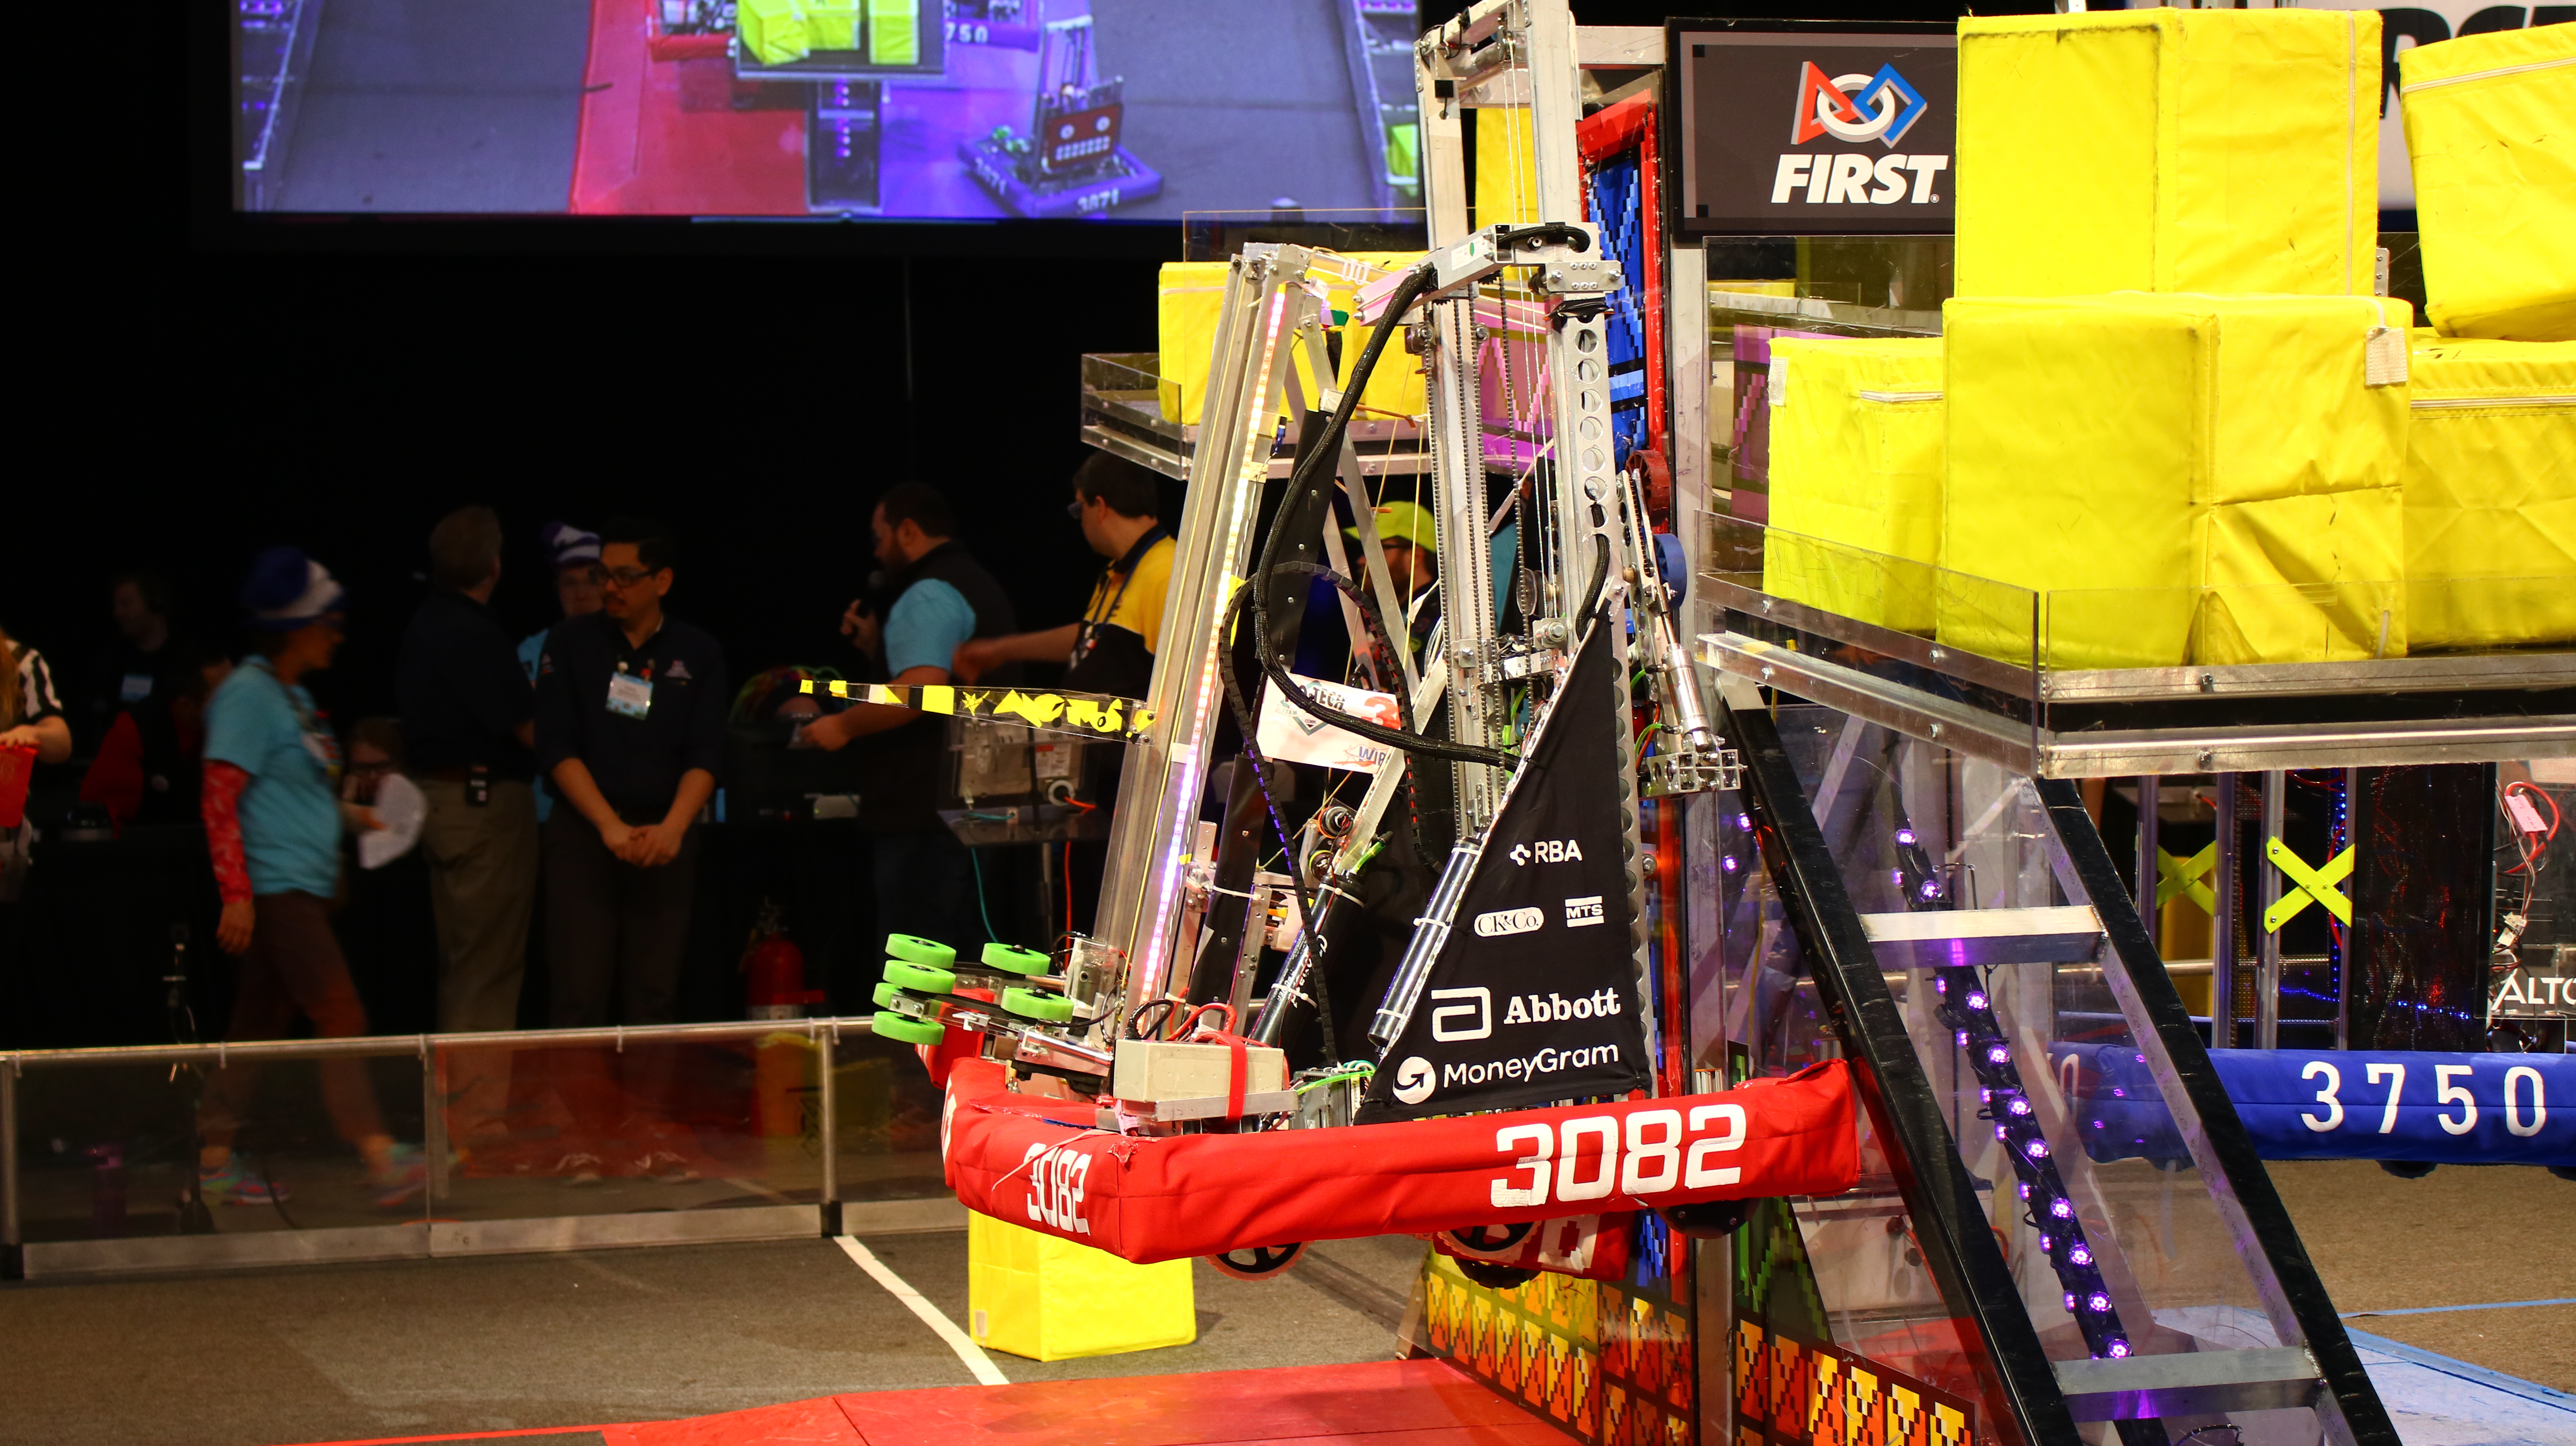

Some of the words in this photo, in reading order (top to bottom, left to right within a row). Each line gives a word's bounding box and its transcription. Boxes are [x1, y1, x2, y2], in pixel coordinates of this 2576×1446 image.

[1534, 839, 1583, 863] RBA
[1478, 911, 1539, 934] CK&Co.
[1566, 904, 1604, 920] MTS
[1504, 987, 1621, 1024] Abbott
[1443, 1044, 1619, 1088] MoneyGram
[2301, 1060, 2547, 1137] 3750
[1490, 1104, 1747, 1208] 3082
[1024, 1142, 1093, 1236] 3082
